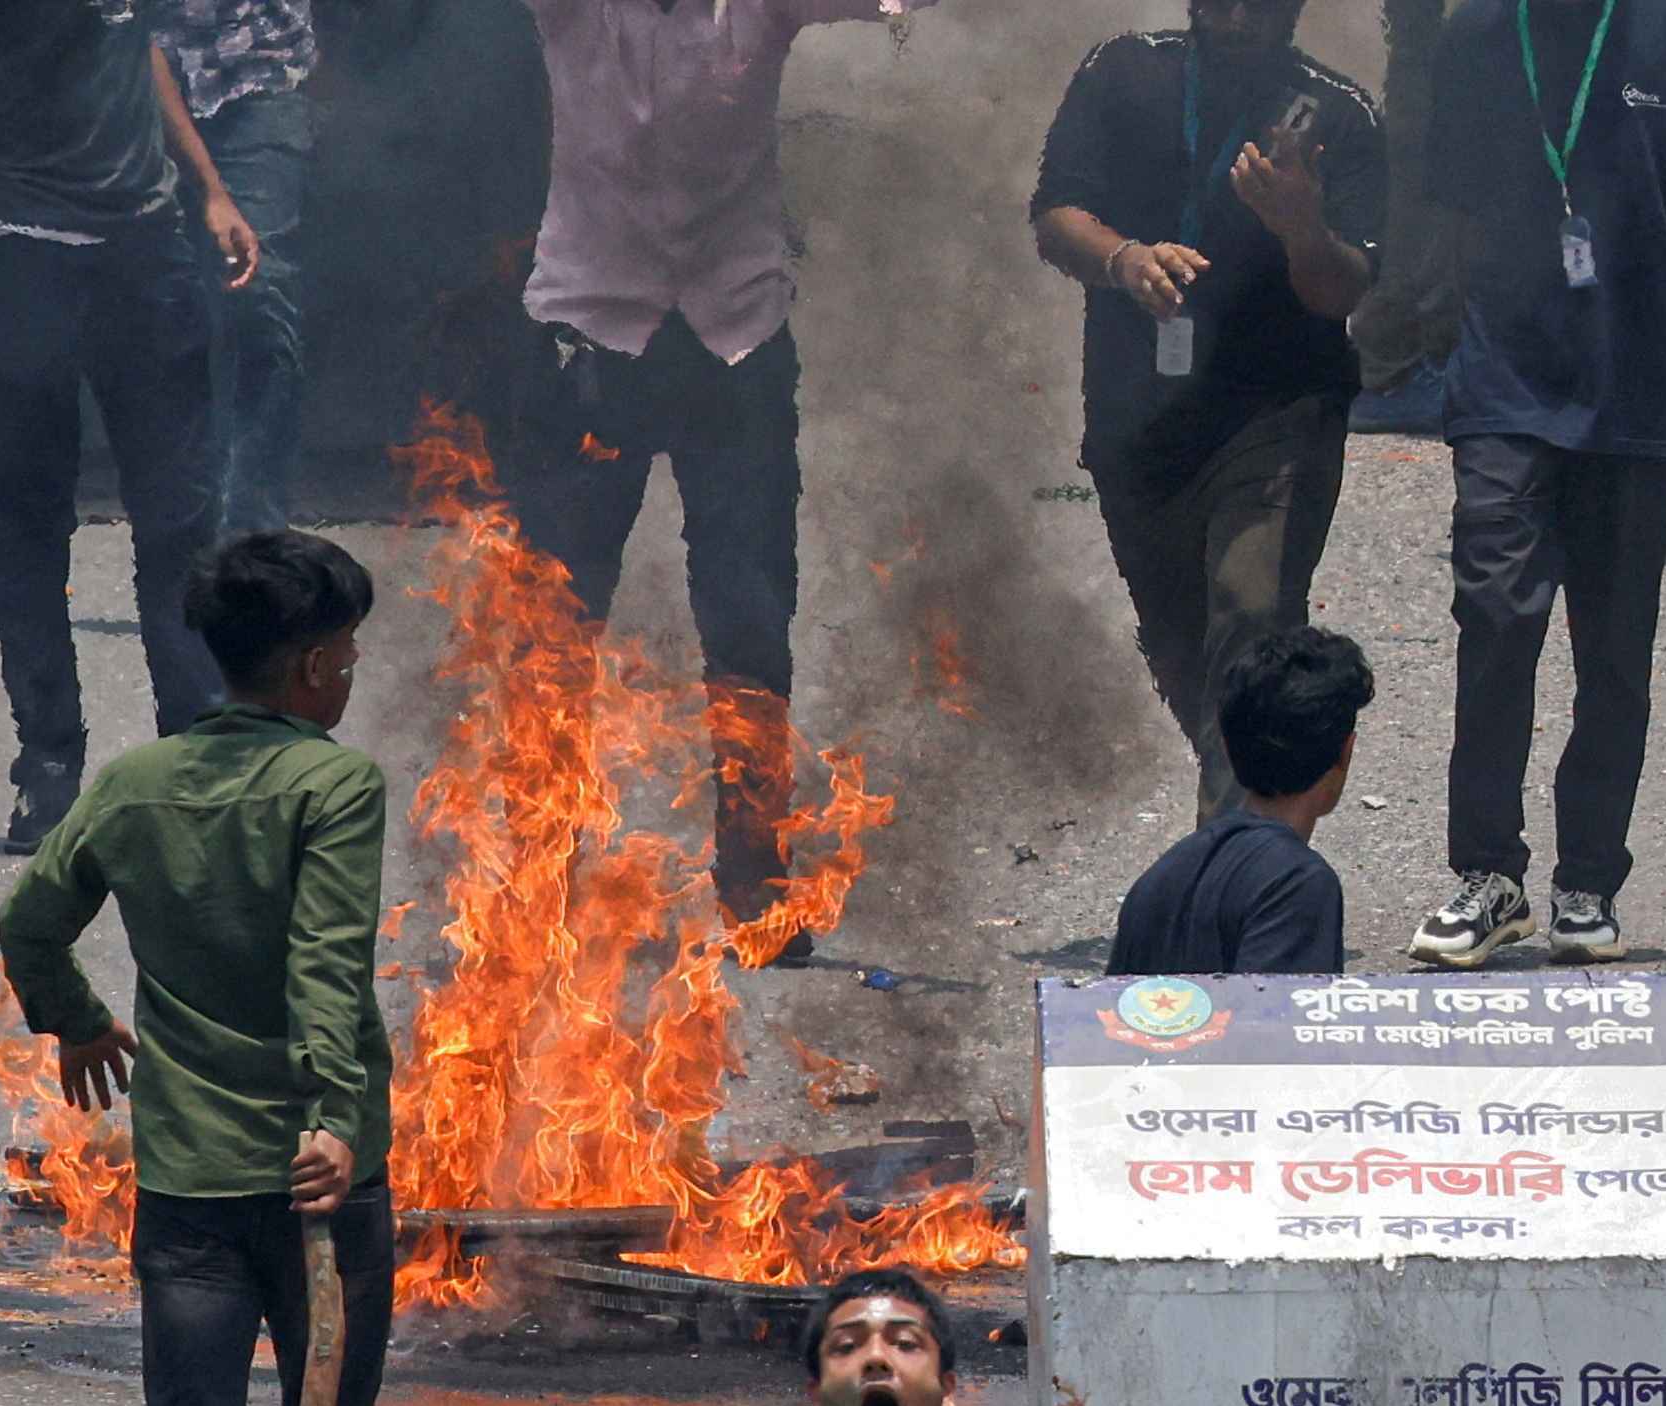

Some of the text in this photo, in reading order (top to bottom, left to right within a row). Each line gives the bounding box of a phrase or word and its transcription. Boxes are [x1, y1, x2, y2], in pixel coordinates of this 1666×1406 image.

[1290, 978, 1420, 1021] পুলিশ
[1433, 986, 1531, 1013] চেক
[1293, 1019, 1654, 1050] ঢাকা মেট্রোপলিটন পুলিশ
[1126, 1099, 1664, 1138] ওমেরা এলপিজি সিলিন্ডার
[1126, 1160, 1254, 1201] হোম
[1278, 1148, 1565, 1202] ডেলিভারি
[1278, 1215, 1361, 1240] কল
